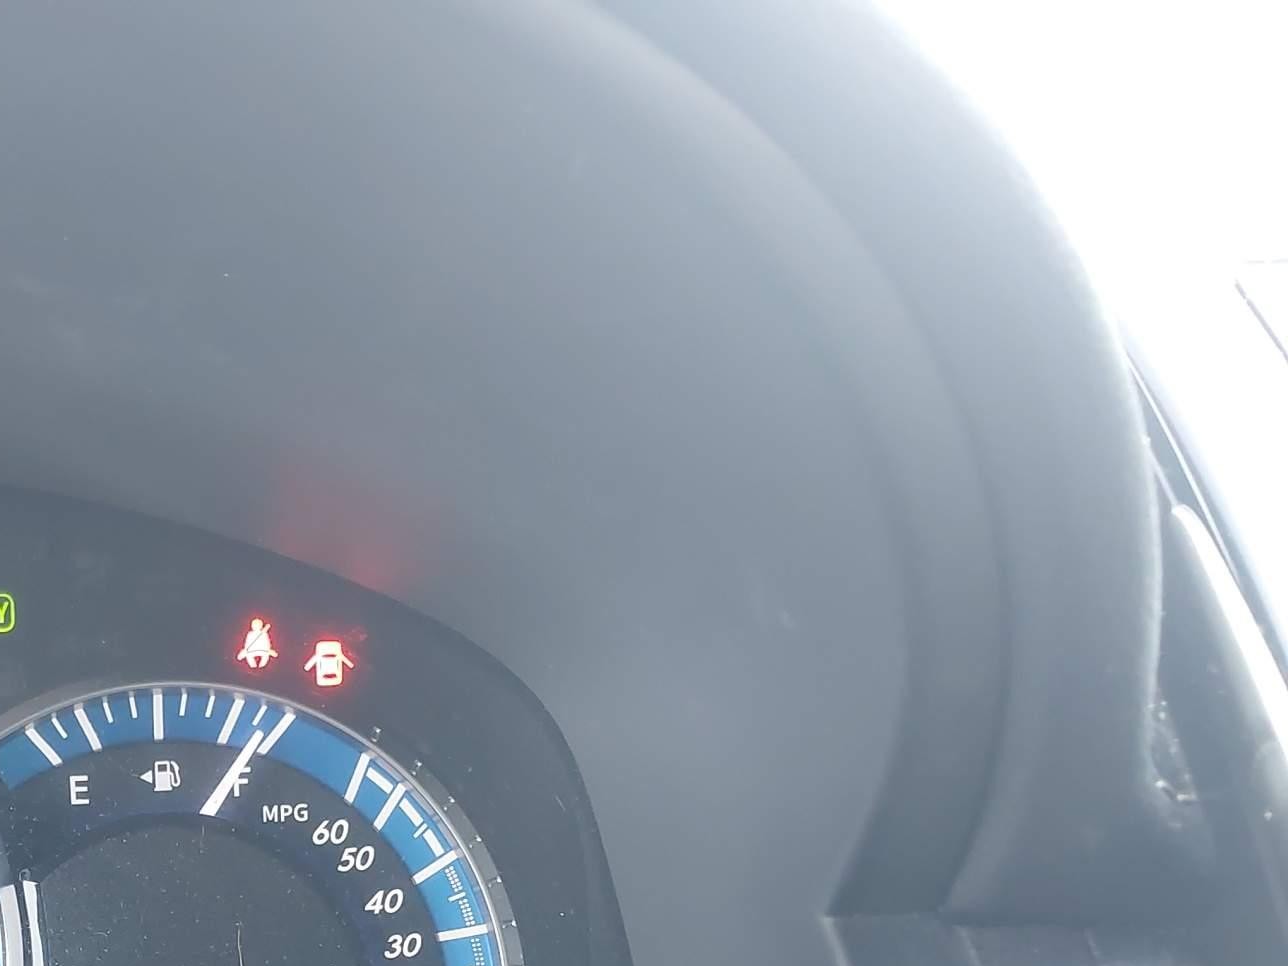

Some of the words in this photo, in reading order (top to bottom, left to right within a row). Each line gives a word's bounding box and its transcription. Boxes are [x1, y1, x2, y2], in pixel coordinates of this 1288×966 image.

[69, 775, 90, 805] E
[262, 803, 309, 823] MPG
[312, 819, 349, 845] 60
[337, 845, 375, 872] 50
[364, 888, 405, 915] 40
[383, 931, 423, 959] 30
